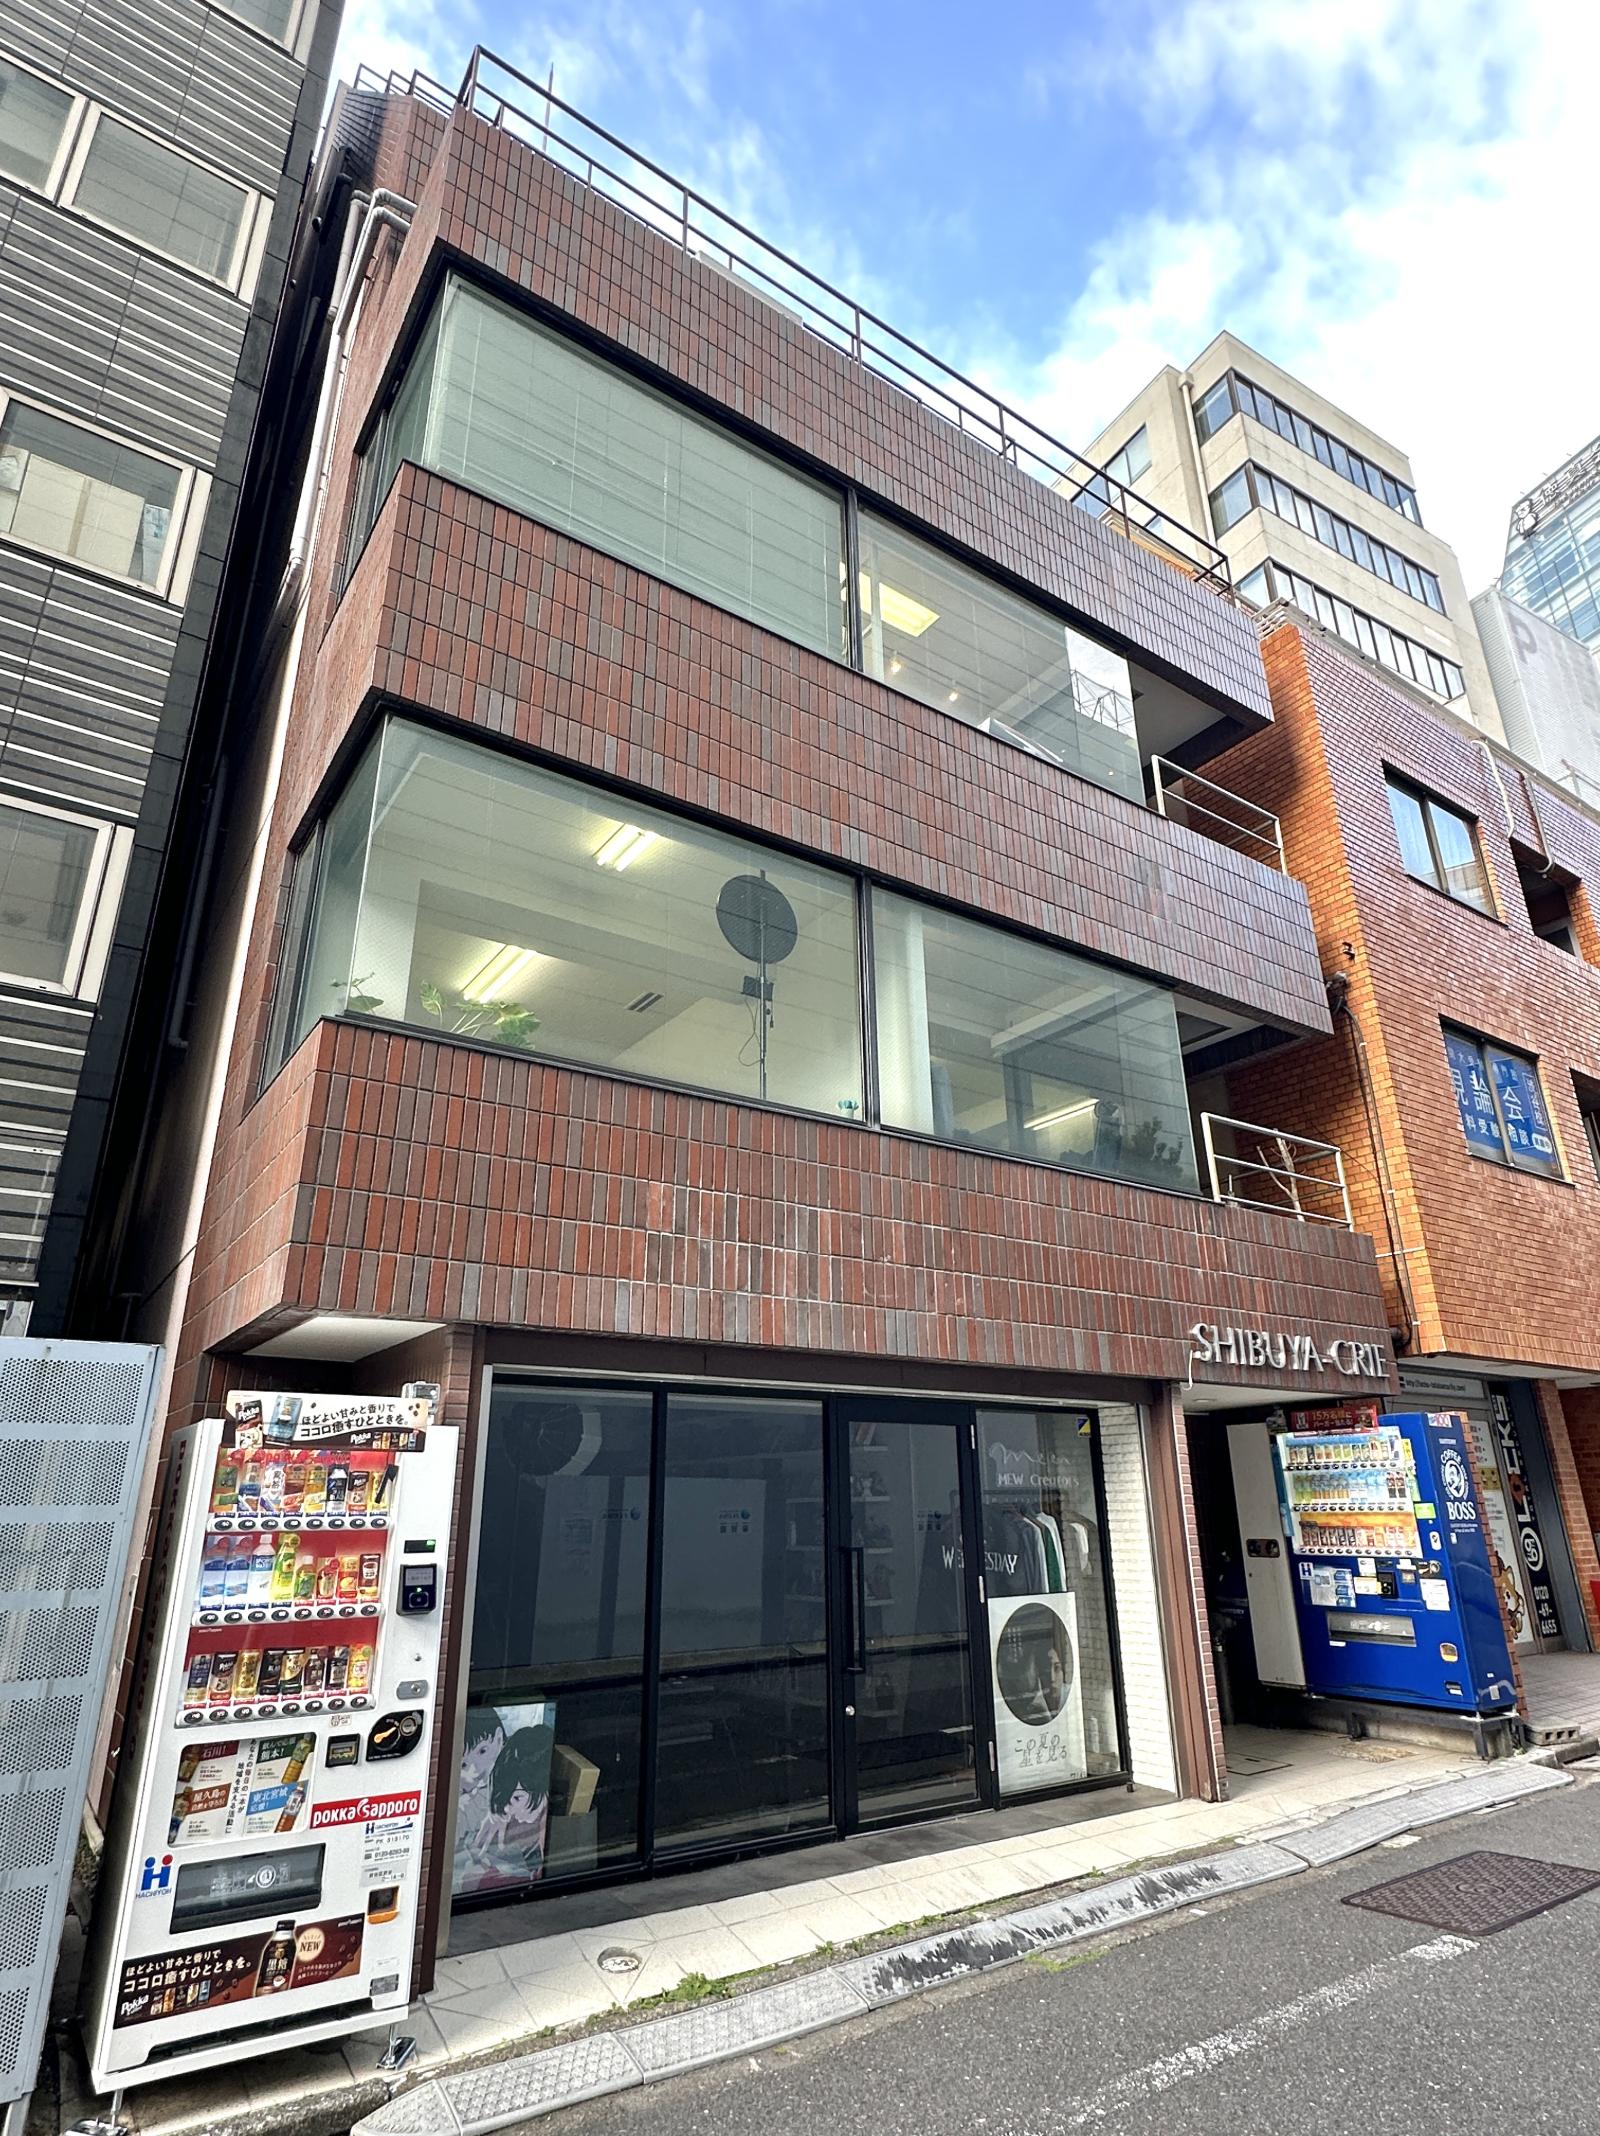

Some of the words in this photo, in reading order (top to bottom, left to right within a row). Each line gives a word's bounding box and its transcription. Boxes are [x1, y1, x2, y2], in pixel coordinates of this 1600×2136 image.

[1191, 1323, 1390, 1378] SHIBUYA-CRIE
[301, 1404, 396, 1425] ほどよい甘みと香りで
[1446, 1501, 1476, 1520] BOSS
[357, 1799, 418, 1819] sapporo
[300, 1940, 321, 1953] NEW
[126, 1949, 222, 1977] ほどよい甘みと香りで
[123, 1956, 251, 1993] ココロ癒すひとときを。
[120, 1994, 150, 2016] Pokka
